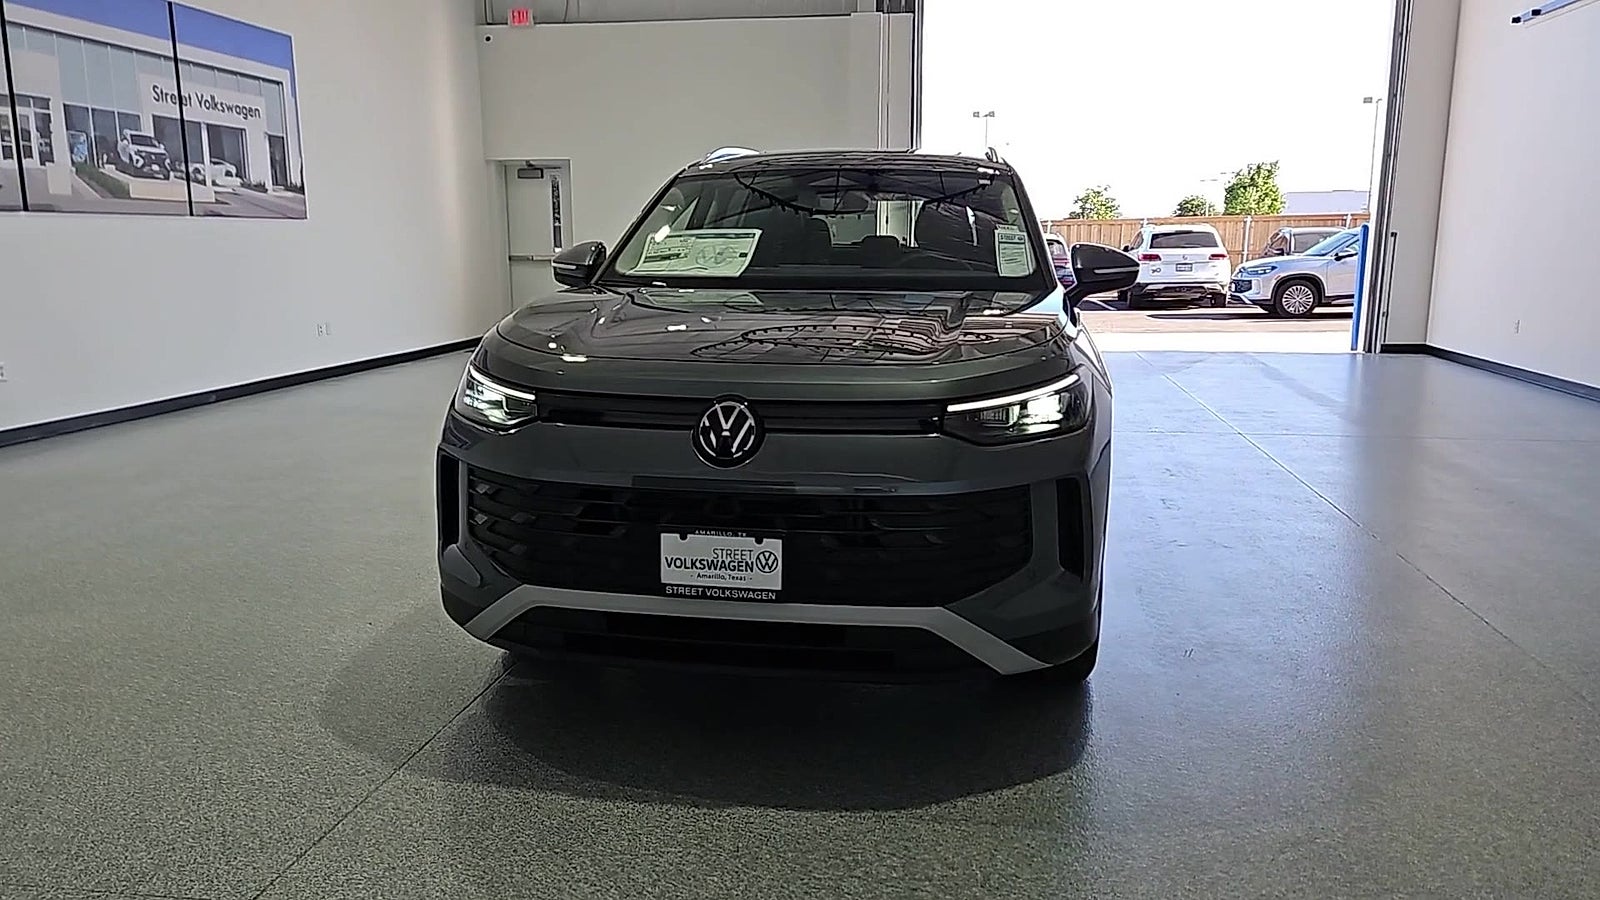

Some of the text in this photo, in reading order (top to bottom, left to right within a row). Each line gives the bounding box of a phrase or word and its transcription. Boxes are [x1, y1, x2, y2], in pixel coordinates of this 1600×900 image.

[152, 84, 261, 120] Street Volkswagen
[712, 548, 754, 560] STREET
[665, 556, 754, 573] VOLKSWAGEN
[728, 573, 747, 582] Texas
[665, 585, 776, 600] STREET VOLKSWAGEN
